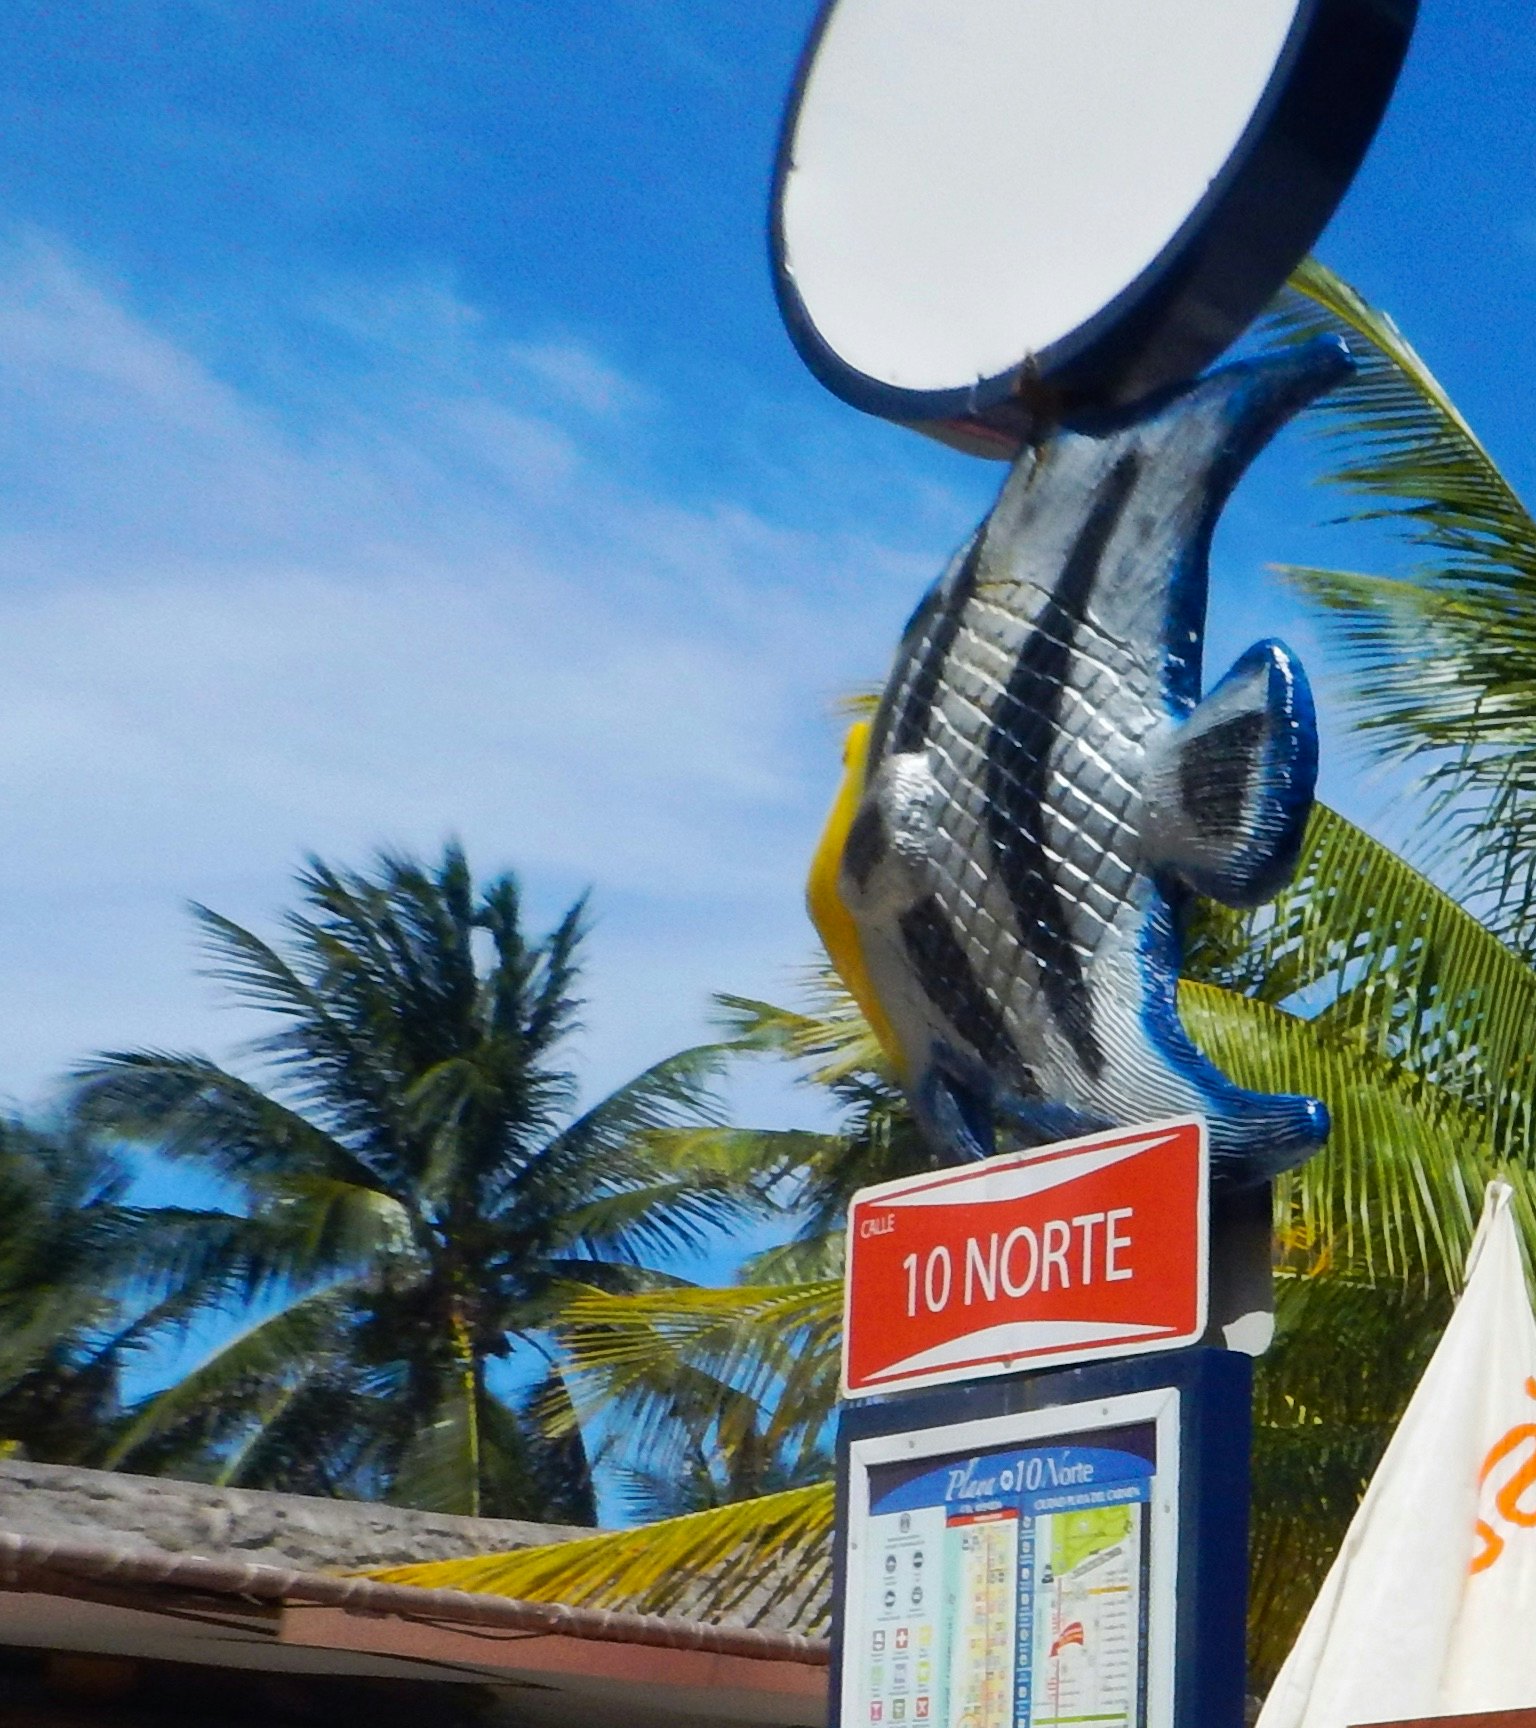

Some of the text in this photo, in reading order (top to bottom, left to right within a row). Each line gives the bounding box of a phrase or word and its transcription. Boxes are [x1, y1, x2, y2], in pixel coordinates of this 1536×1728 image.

[860, 1213, 895, 1239] CALLE
[903, 1207, 1134, 1317] 10 NORTE
[1016, 1458, 1041, 1492] 10
